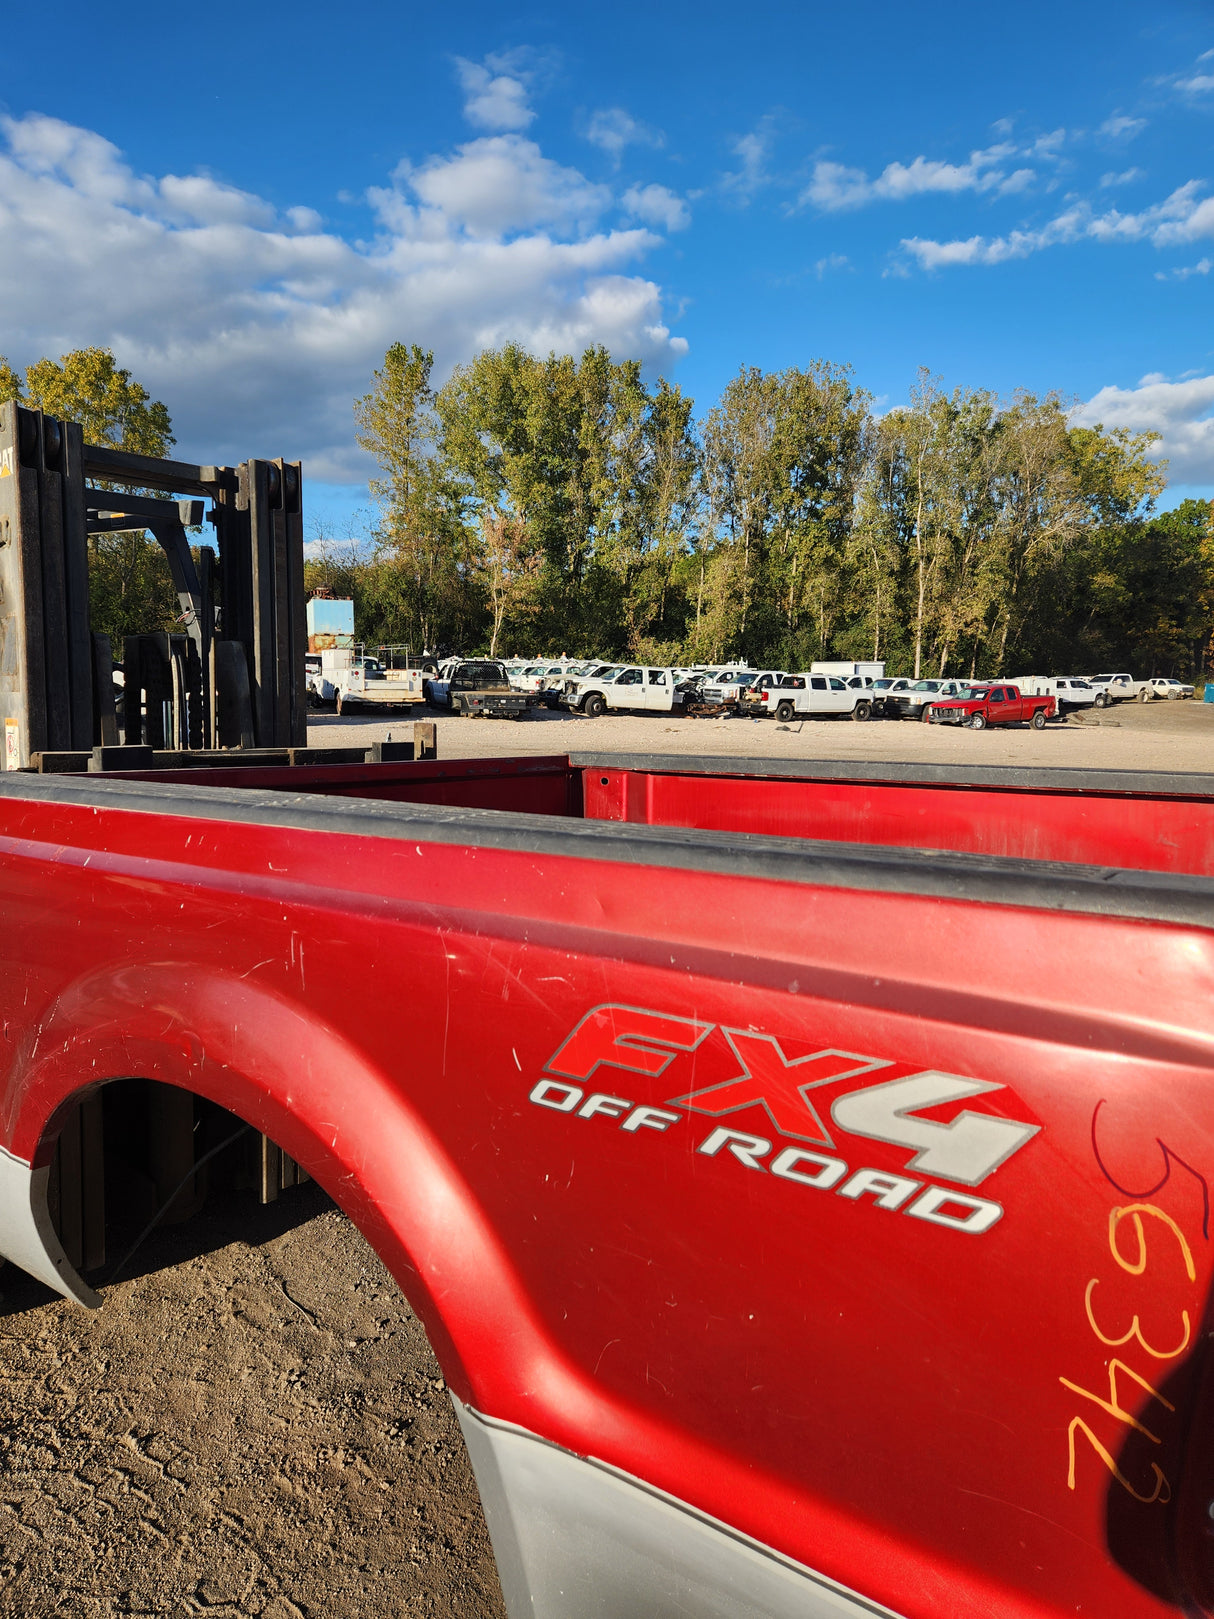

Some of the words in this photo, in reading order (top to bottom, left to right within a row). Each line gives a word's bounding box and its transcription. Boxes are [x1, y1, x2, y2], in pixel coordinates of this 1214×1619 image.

[0, 446, 13, 474] AT
[529, 1078, 683, 1133] OFF
[697, 1126, 1004, 1235] ROAD
[543, 1003, 1042, 1187] FX4
